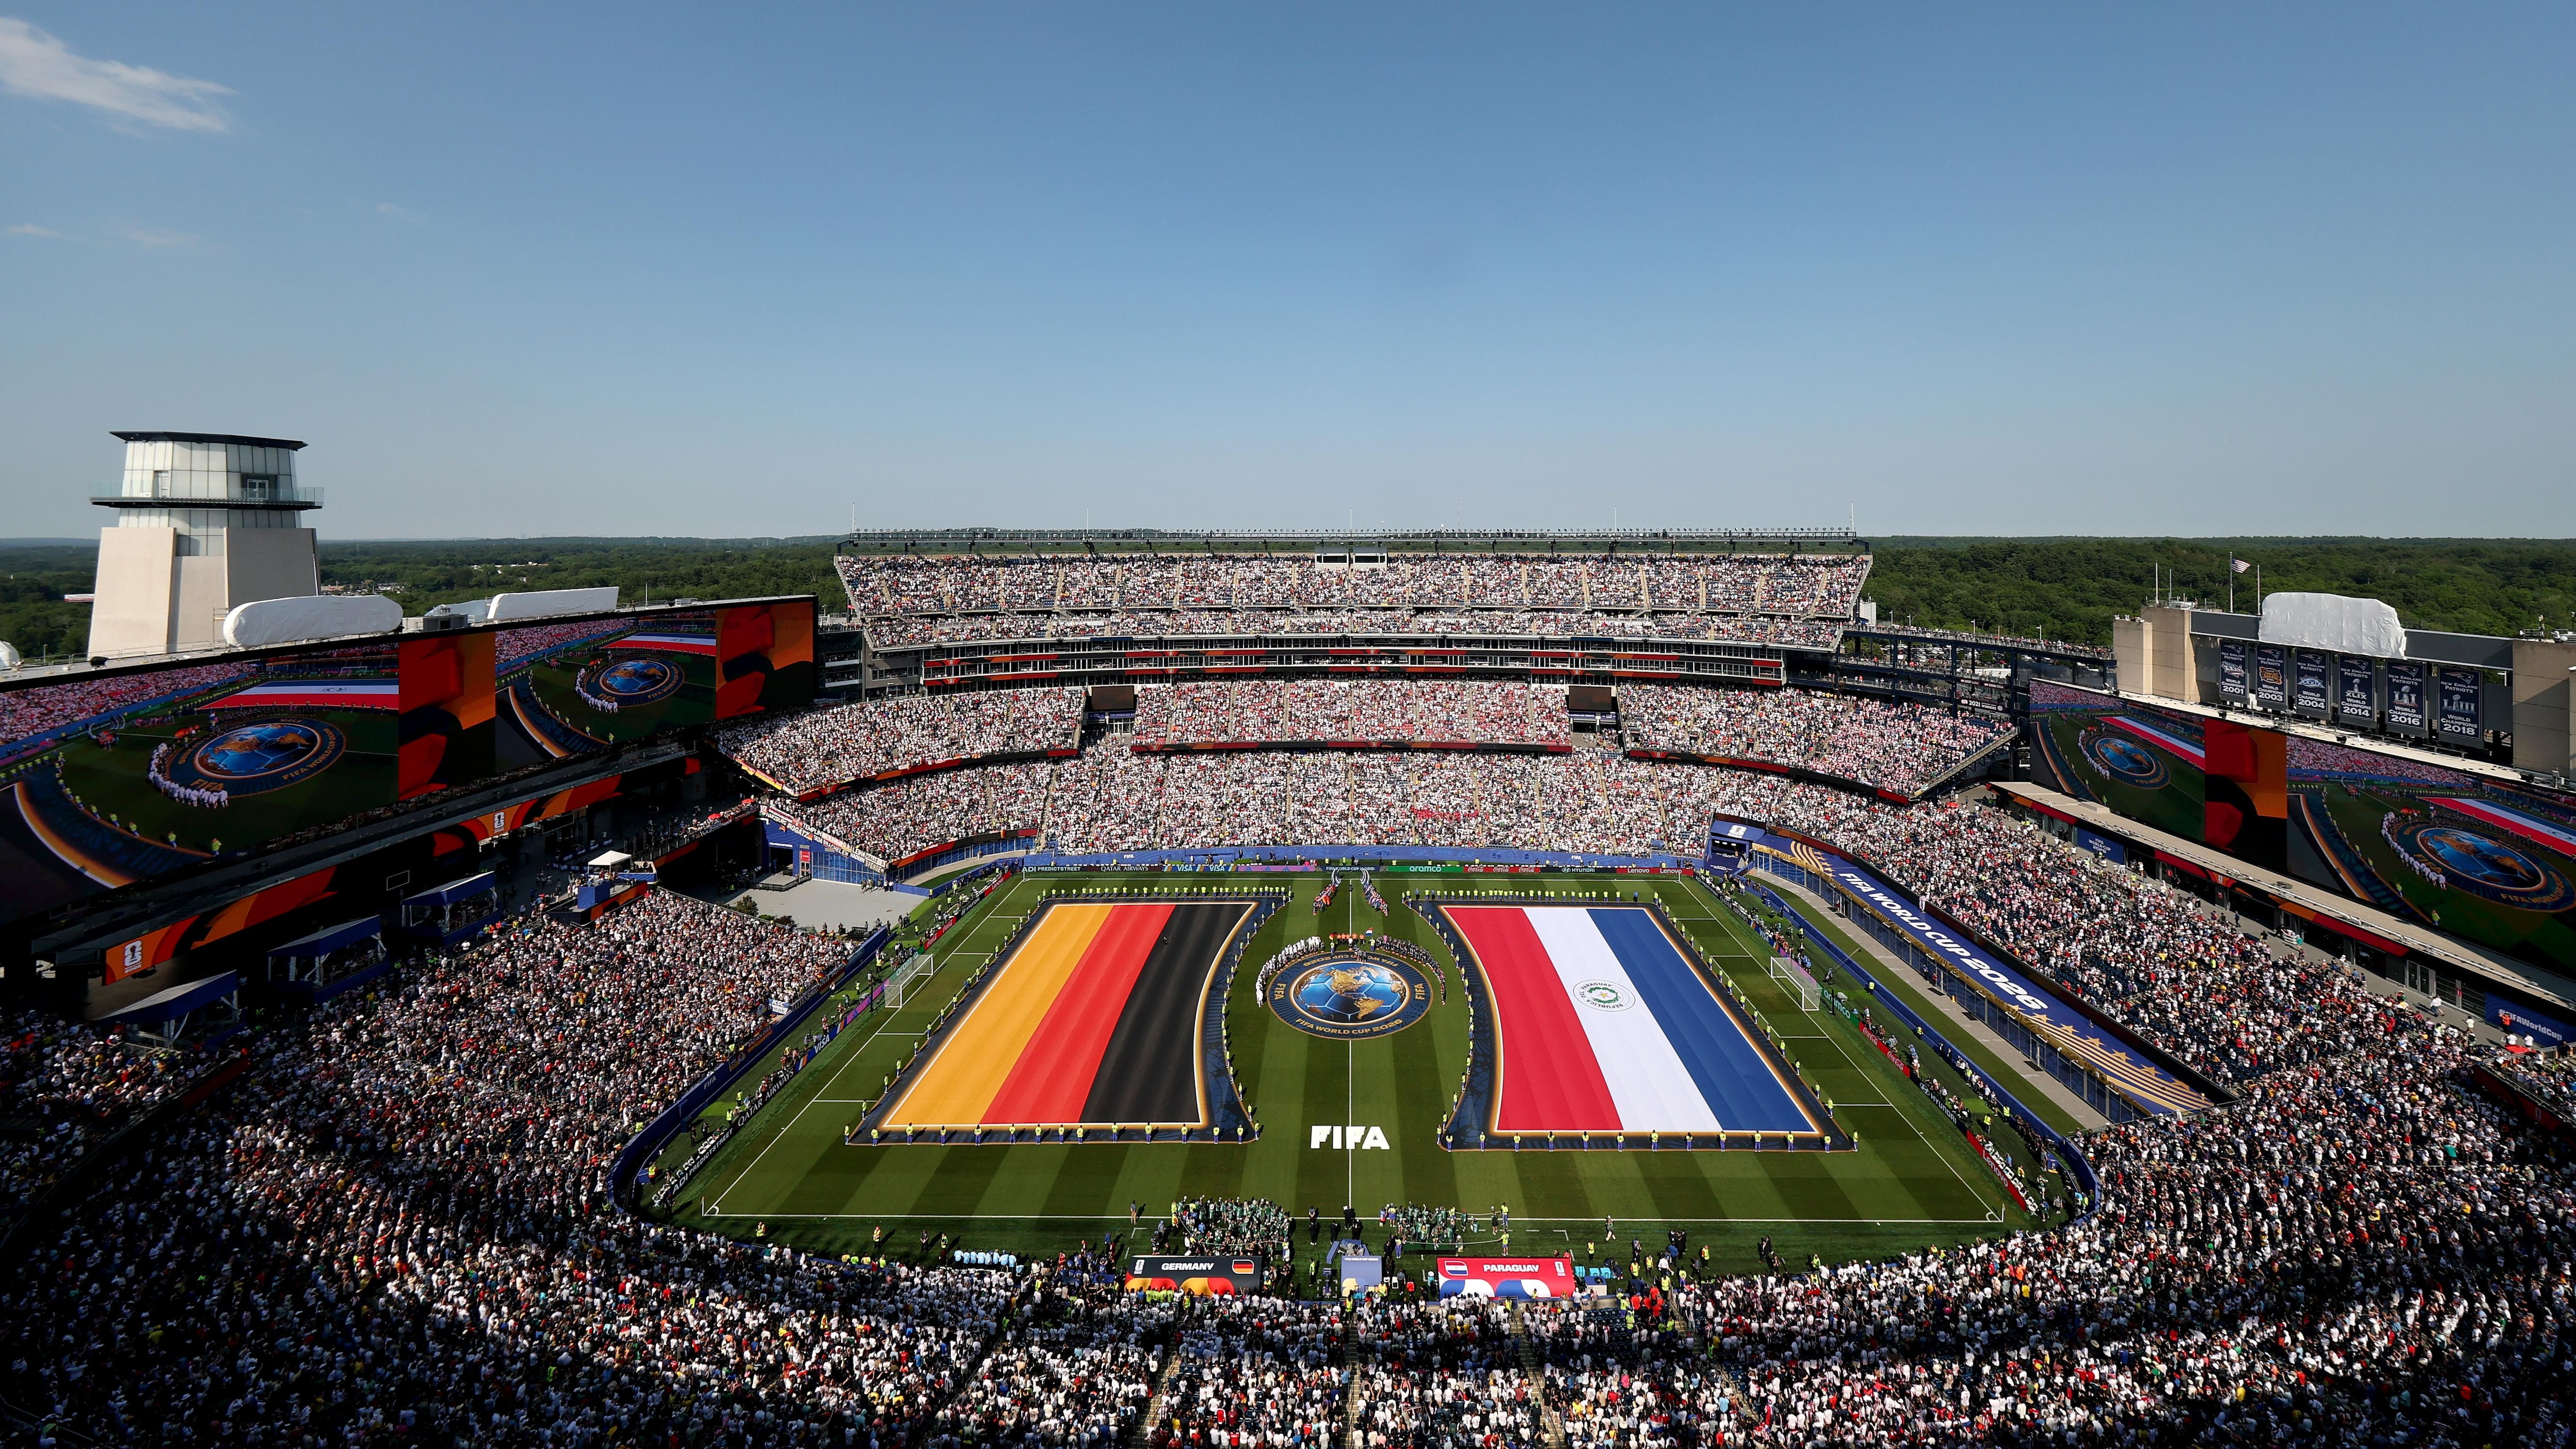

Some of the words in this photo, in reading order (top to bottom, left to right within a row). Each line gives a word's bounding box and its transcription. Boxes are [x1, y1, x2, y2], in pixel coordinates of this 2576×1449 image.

[2223, 686, 2244, 695] 2001
[2345, 691, 2367, 700] XLIX
[2445, 685, 2473, 694] PATRIOTS
[598, 693, 616, 702] FIFA
[2259, 692, 2283, 701] 2003
[2298, 699, 2325, 709] 2004
[2341, 701, 2371, 710] CHAMPIONS
[2343, 706, 2369, 716] 2014
[2388, 709, 2421, 719] CHAMPIONS
[2391, 715, 2420, 726] 2016
[2441, 718, 2478, 728] CHAMPIONS
[2443, 723, 2475, 735] 2018
[283, 768, 308, 780] FIFA
[190, 778, 224, 791] FIFA
[1739, 812, 1766, 823] KETSCH
[803, 823, 822, 837] TEMPLIN
[2089, 839, 2103, 848] WORLD
[992, 878, 1004, 890] Lenovo
[2499, 893, 2530, 903] FIFA
[1720, 896, 1732, 908] QATAR
[1733, 907, 1748, 922] AIRWAYS
[1759, 928, 1769, 943] VISA
[1838, 872, 1876, 894] FIFA
[1869, 892, 1932, 931] WORLD
[1924, 931, 1971, 957] CUP
[1960, 957, 2048, 1009] 2026
[1275, 983, 1286, 1000] FIFA
[1415, 983, 1425, 1000] FIFA
[1295, 1018, 1314, 1029] FIFA
[1315, 1025, 1350, 1034] WORLD
[1372, 1018, 1403, 1033] 2026
[815, 1035, 830, 1054] VISA
[704, 1075, 716, 1090] FIFA
[738, 1098, 762, 1126] QATAR
[766, 1070, 794, 1100] AIRWAYS
[1931, 1095, 1957, 1124] HYUNDAI
[1311, 1125, 1390, 1150] FIFA
[673, 1172, 688, 1194] ADI
[689, 1128, 733, 1176] PREDICTSTREET
[1983, 1149, 2009, 1187] Lenovo
[1161, 1262, 1214, 1271] GERMANY
